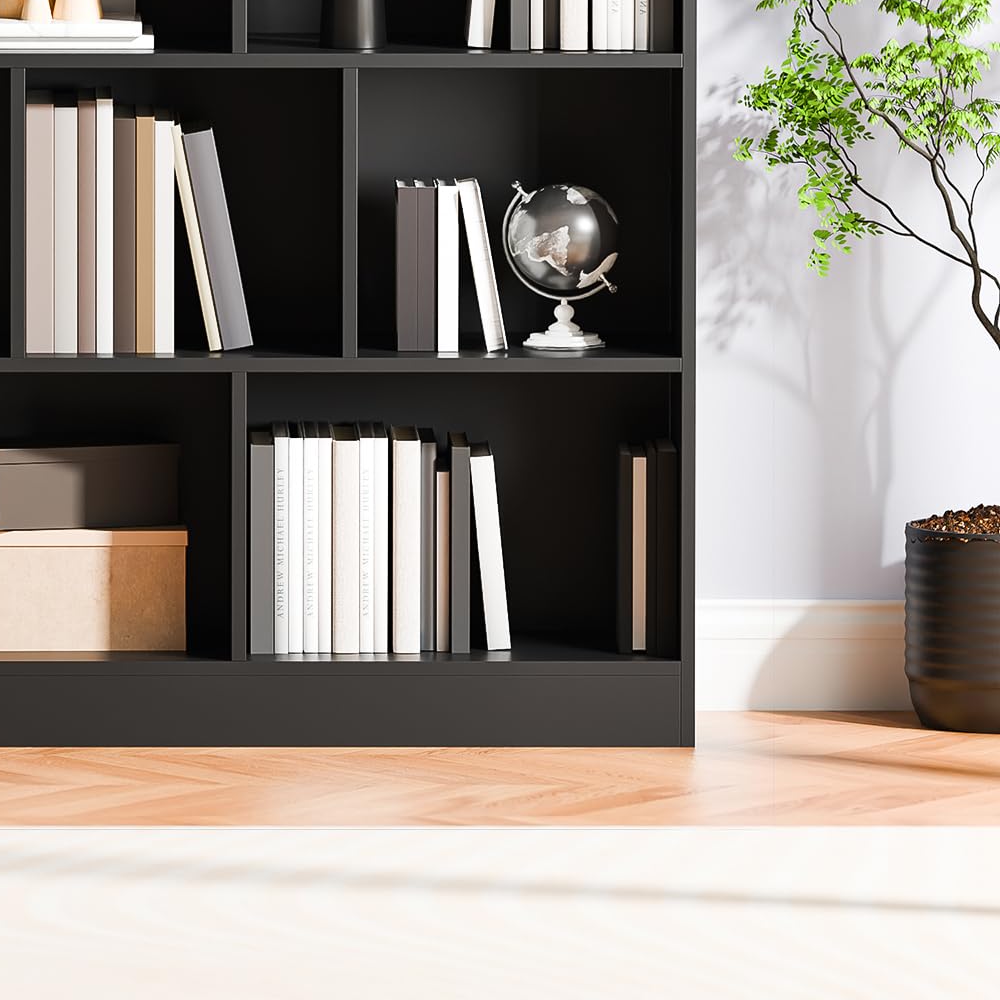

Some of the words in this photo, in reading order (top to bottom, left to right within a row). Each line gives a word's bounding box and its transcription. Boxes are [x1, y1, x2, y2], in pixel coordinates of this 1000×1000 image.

[276, 467, 285, 512] HURLEY
[276, 515, 285, 566] MICHAEL
[276, 570, 285, 619] ANDREW
